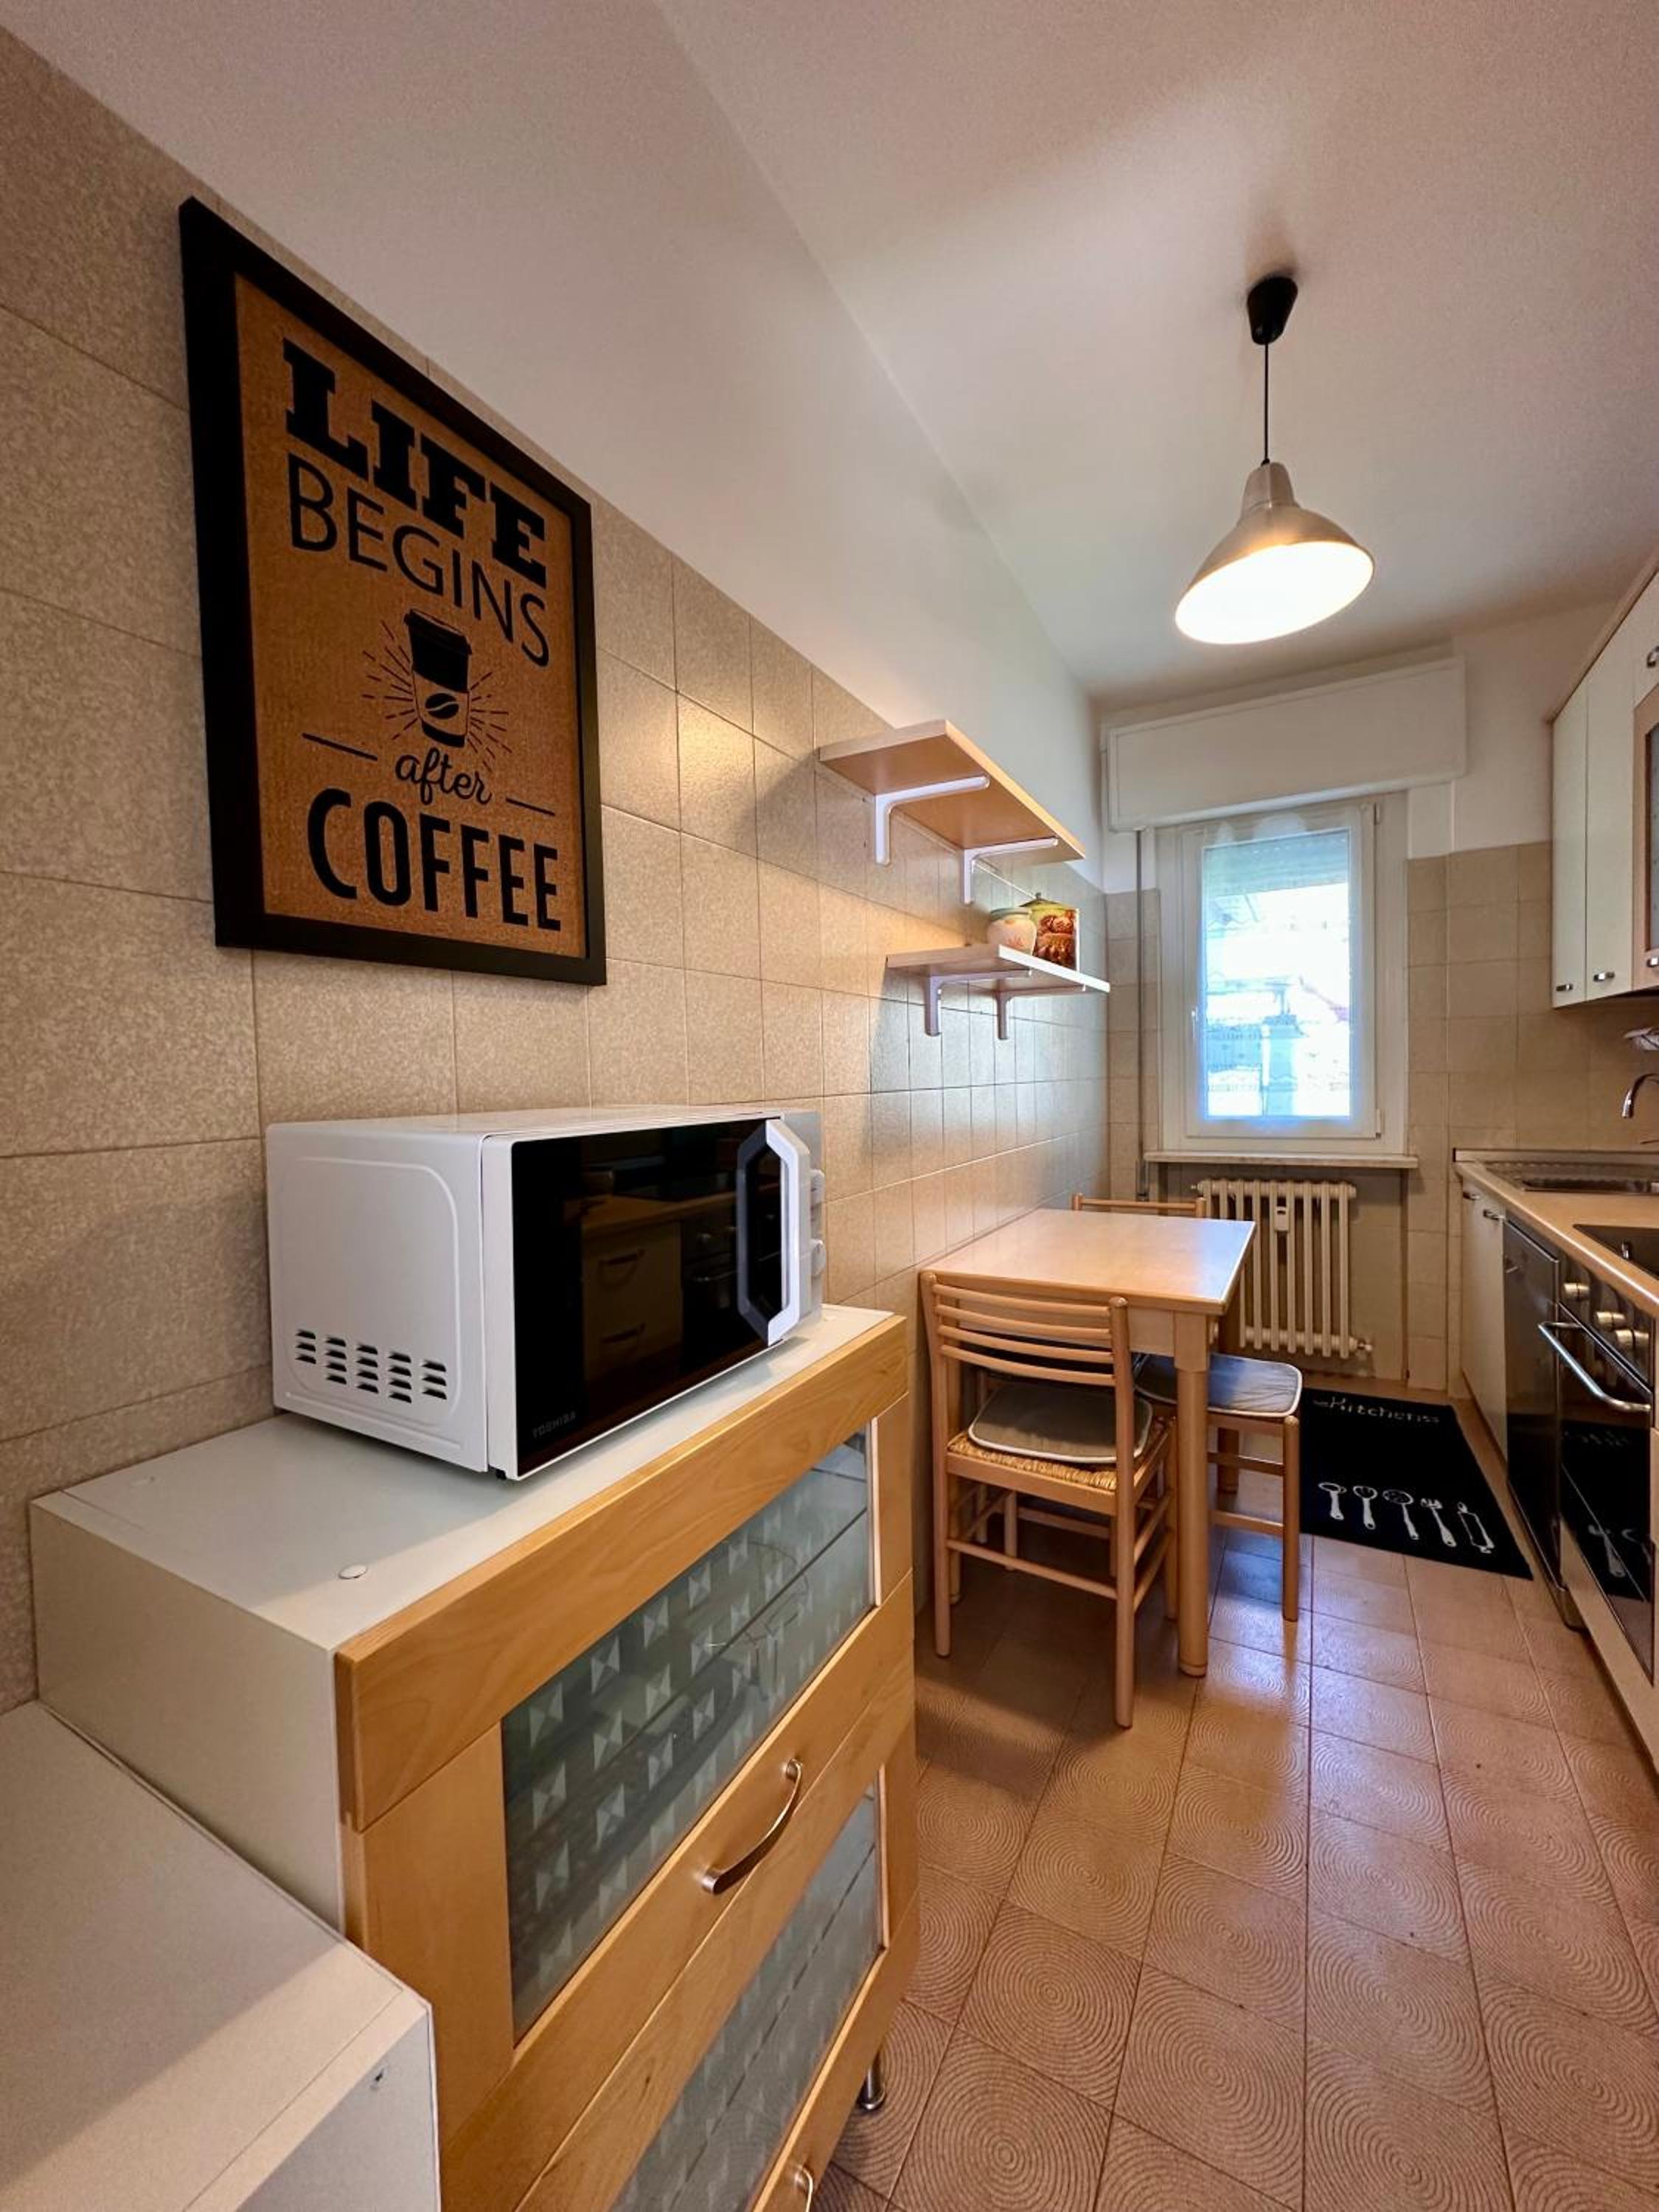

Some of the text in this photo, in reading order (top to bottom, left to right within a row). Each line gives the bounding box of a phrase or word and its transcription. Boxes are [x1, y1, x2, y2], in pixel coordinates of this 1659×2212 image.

[282, 338, 546, 588] LIFE
[288, 451, 550, 667] BEGINS
[395, 745, 493, 805] after
[307, 787, 561, 932] COFFEE
[532, 1410, 577, 1439] TOSHIBA
